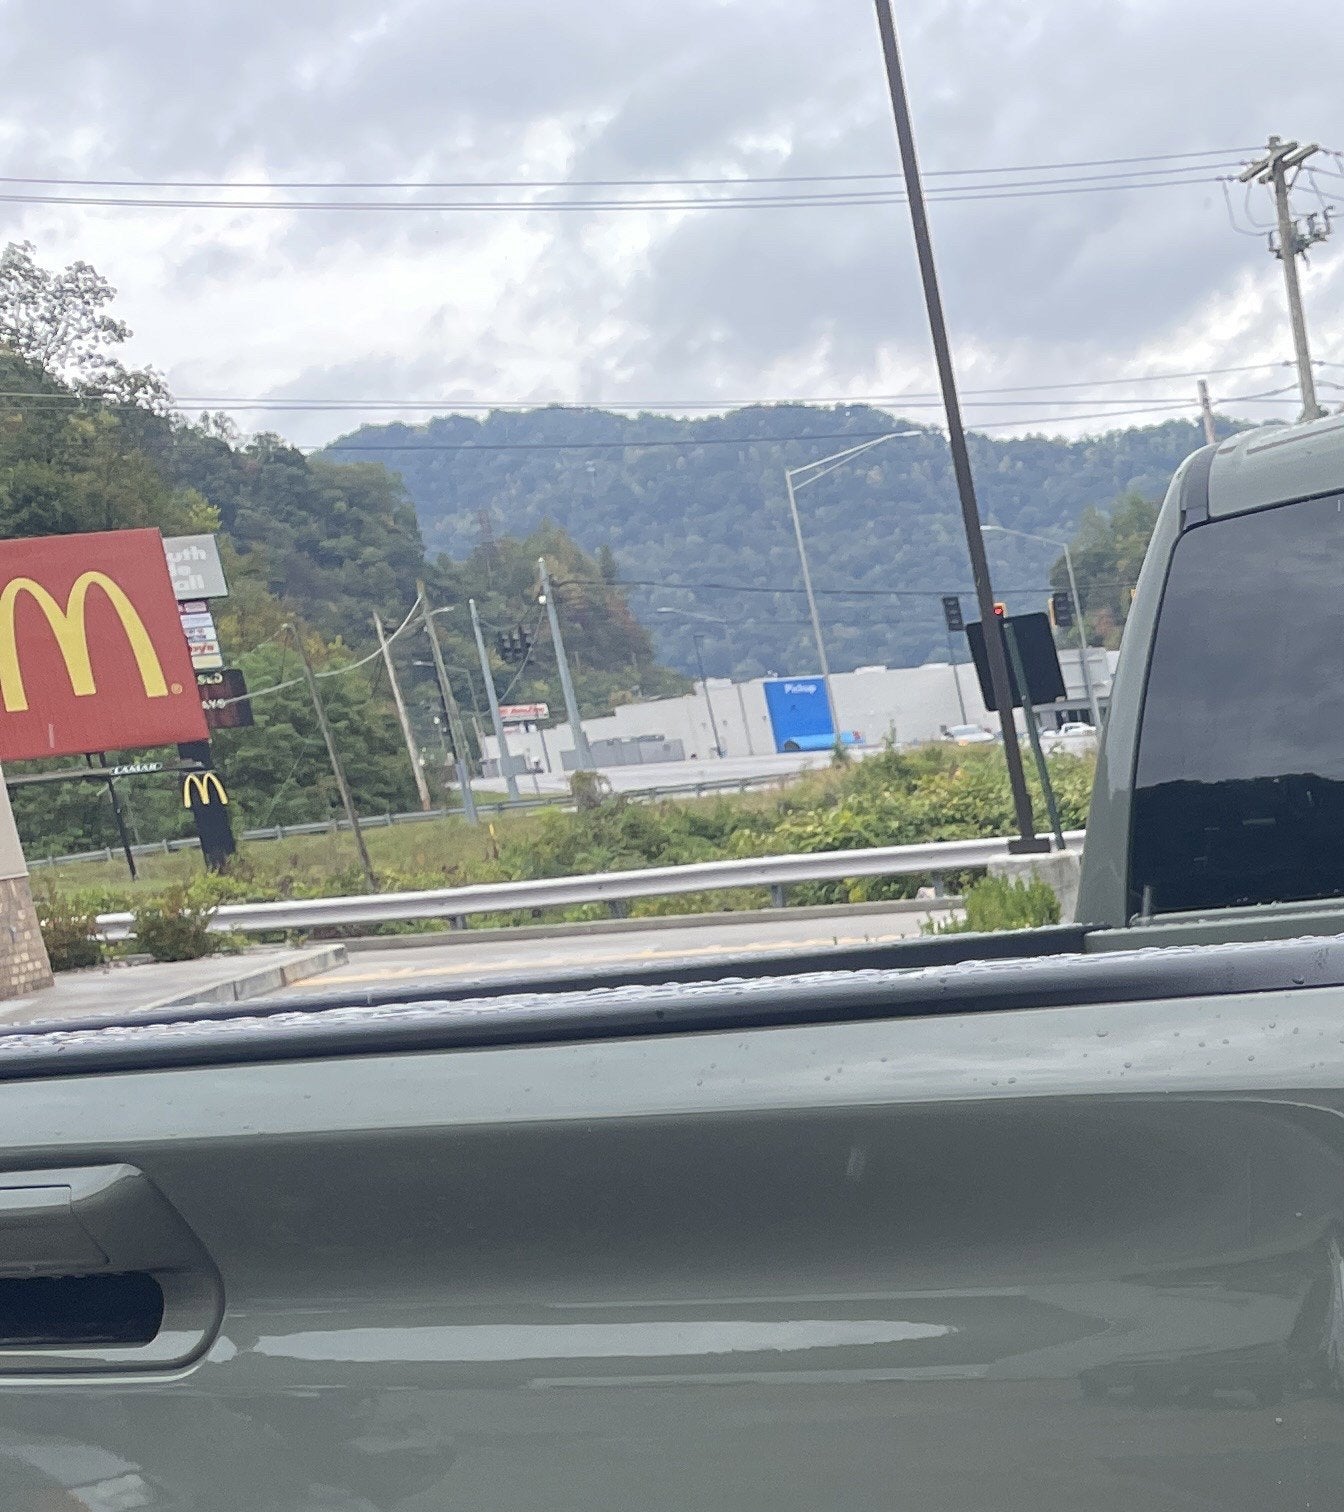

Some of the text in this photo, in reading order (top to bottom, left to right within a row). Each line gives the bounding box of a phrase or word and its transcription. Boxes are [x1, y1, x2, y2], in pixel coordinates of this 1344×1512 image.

[167, 545, 207, 563] uth
[784, 683, 817, 694] Pickup
[113, 762, 158, 775] LAMAR
